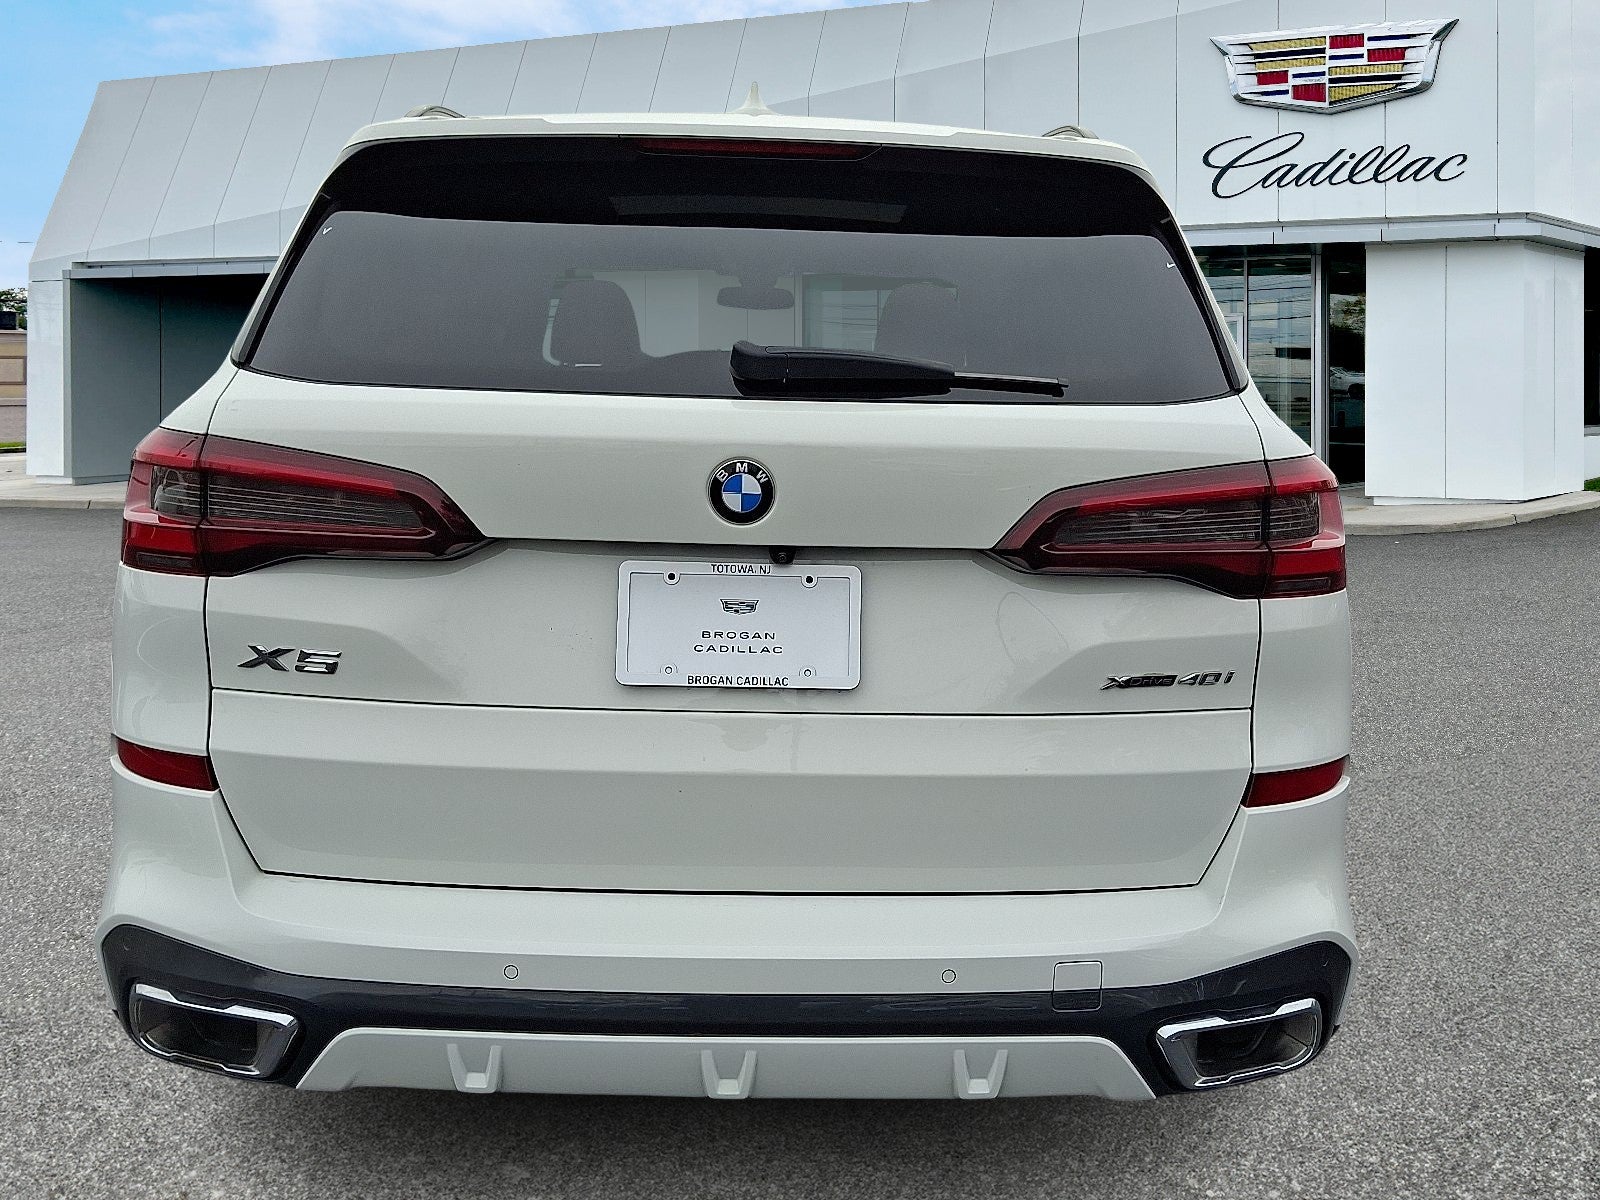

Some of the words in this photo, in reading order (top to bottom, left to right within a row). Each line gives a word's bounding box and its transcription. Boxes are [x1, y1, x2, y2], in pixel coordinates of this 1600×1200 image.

[1202, 131, 1468, 199] Cadillac
[715, 462, 769, 484] BMW
[759, 564, 771, 575] NJ
[701, 630, 776, 640] BROGAN
[693, 644, 783, 654] CADILLAC
[237, 644, 342, 675] X5
[687, 675, 733, 685] BROGAN
[736, 676, 789, 686] CADILLAC
